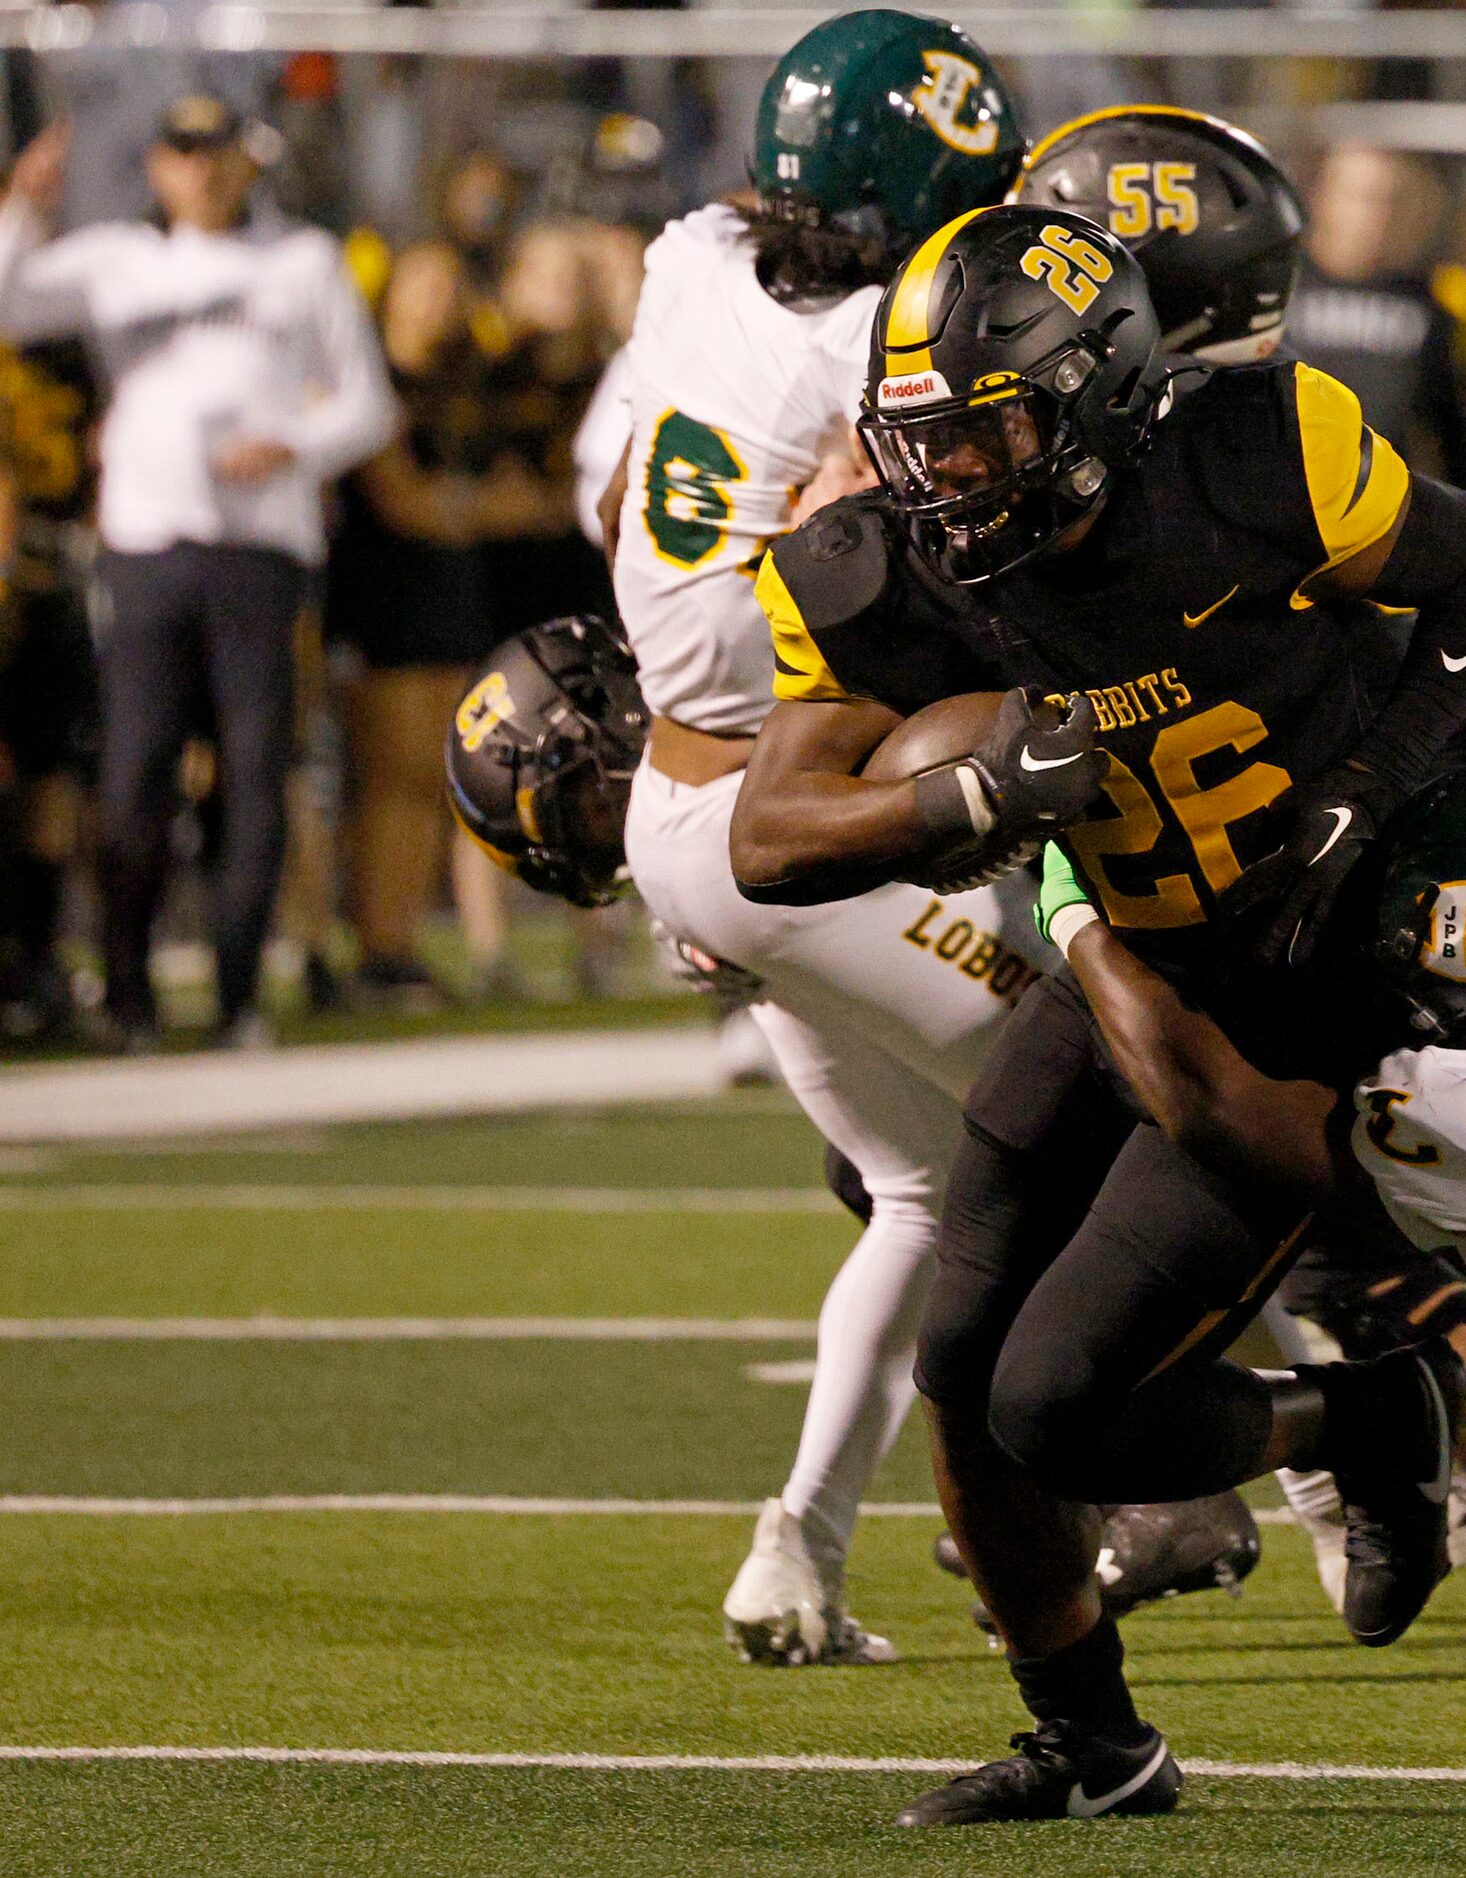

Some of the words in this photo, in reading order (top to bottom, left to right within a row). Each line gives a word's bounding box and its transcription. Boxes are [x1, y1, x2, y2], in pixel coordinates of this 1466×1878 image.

[912, 50, 999, 155] L
[1107, 162, 1200, 237] 55
[1020, 225, 1114, 317] 26
[882, 378, 935, 399] Riddell
[1065, 699, 1294, 930] 26
[1442, 905, 1457, 959] JPB
